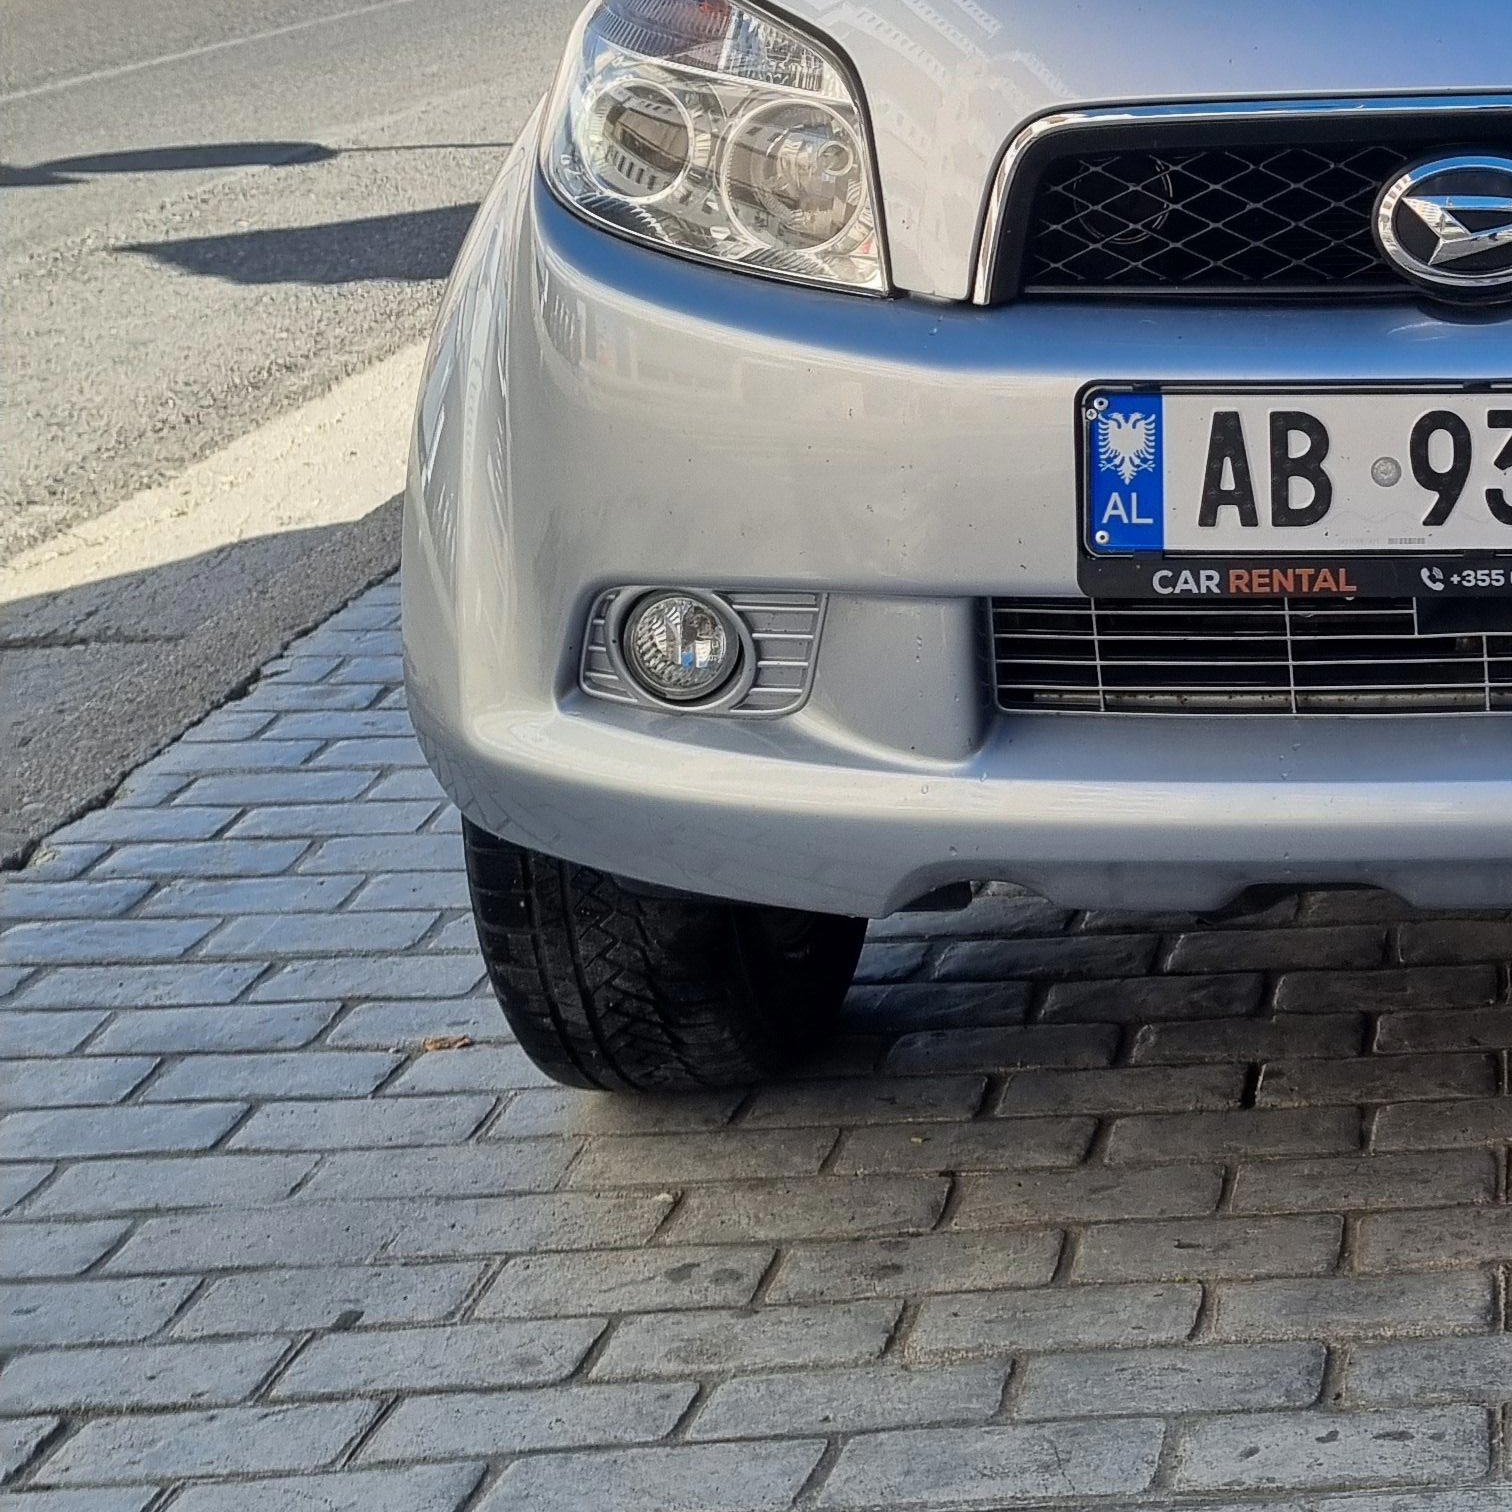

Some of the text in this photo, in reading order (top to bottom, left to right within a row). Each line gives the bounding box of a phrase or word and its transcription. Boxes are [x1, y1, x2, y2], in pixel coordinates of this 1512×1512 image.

[1197, 409, 1334, 528] AB
[1101, 491, 1154, 525] AL
[1152, 567, 1358, 594] CAR RENTAL
[1450, 569, 1505, 587] +355
